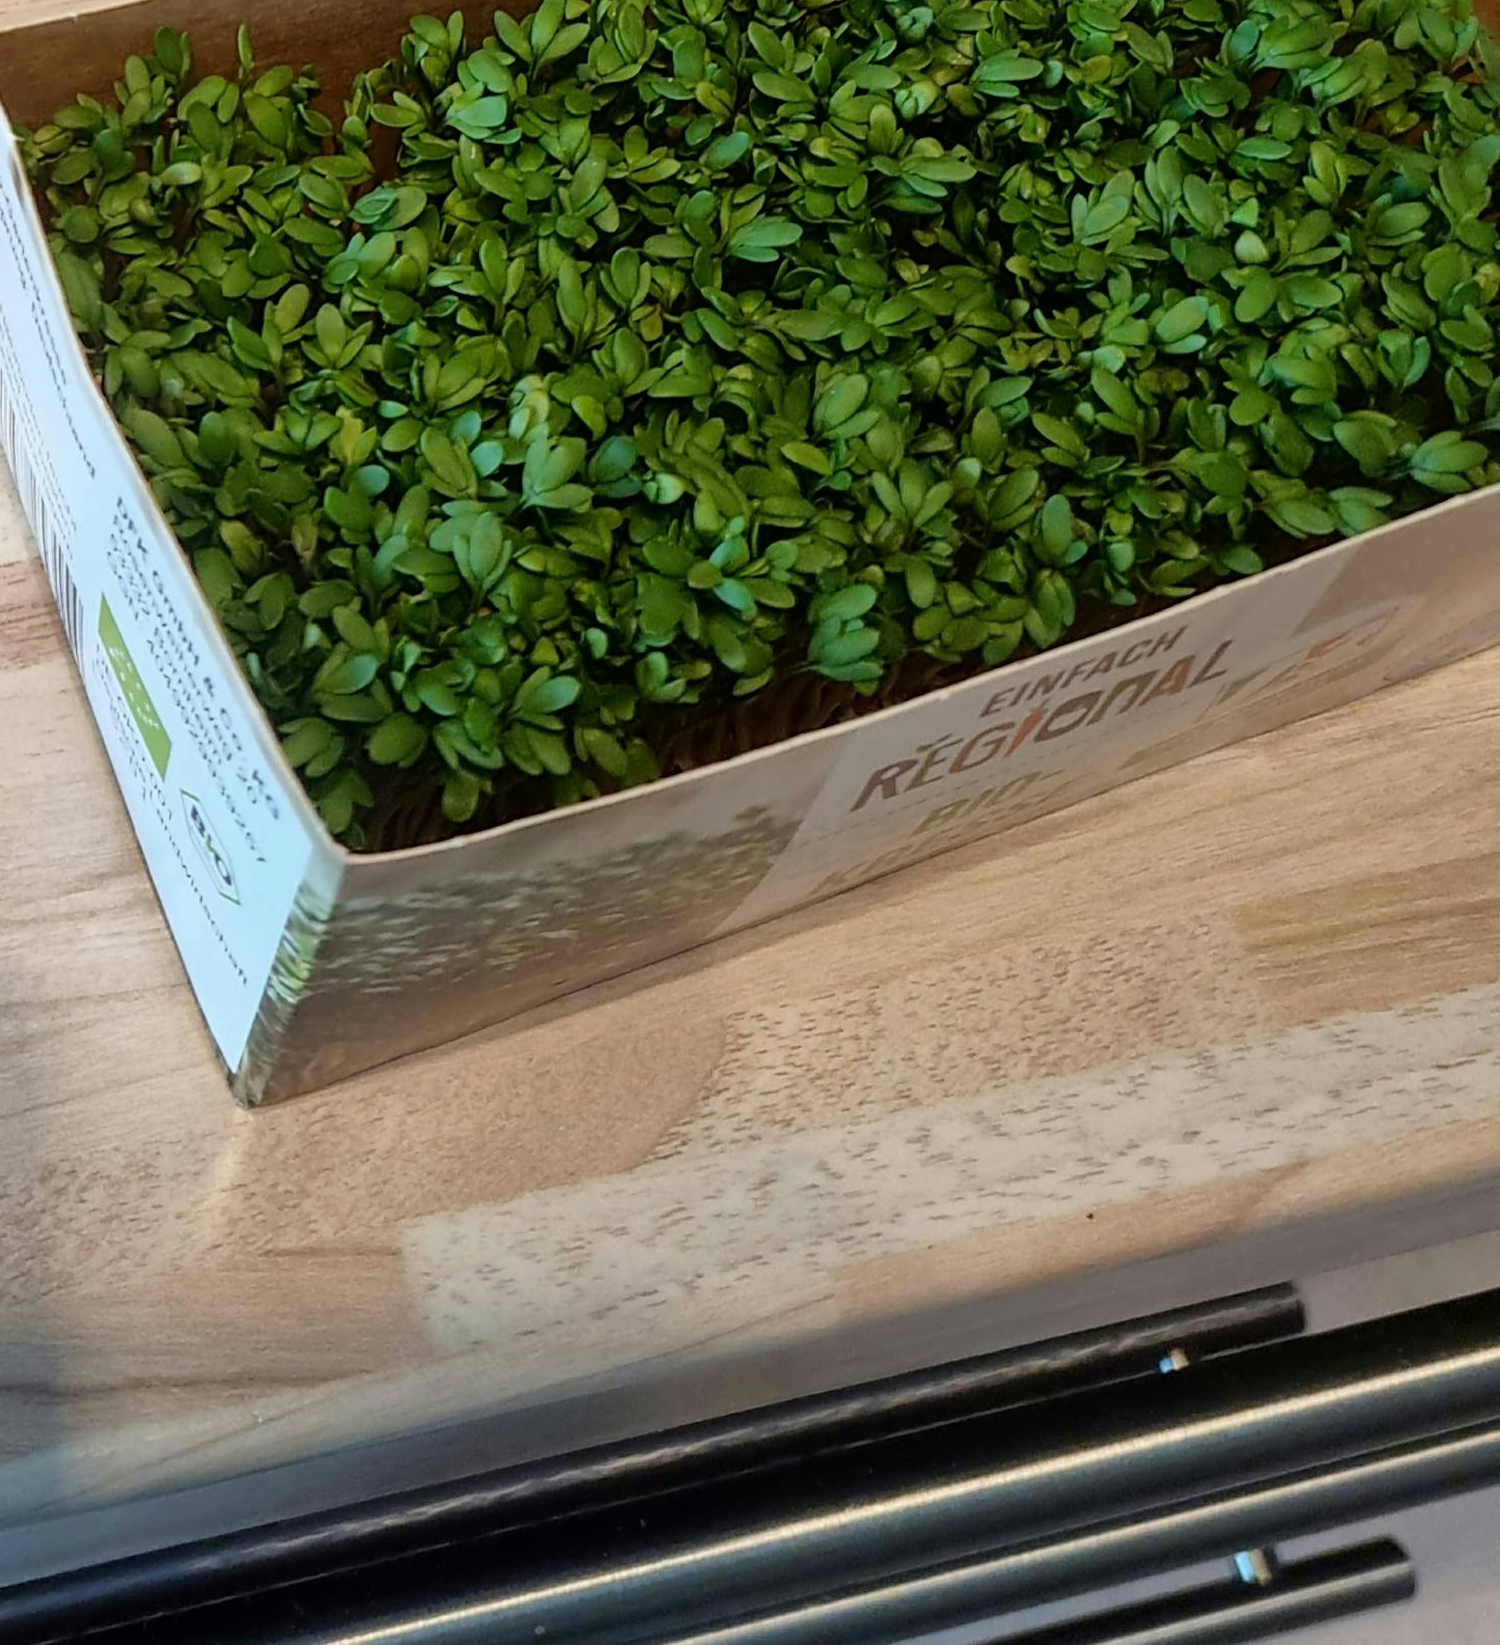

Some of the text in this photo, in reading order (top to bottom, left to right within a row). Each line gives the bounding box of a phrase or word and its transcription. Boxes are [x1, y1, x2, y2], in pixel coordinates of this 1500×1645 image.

[152, 569, 200, 667] GmbH
[252, 768, 279, 820] KG
[979, 624, 1188, 718] EINFACH
